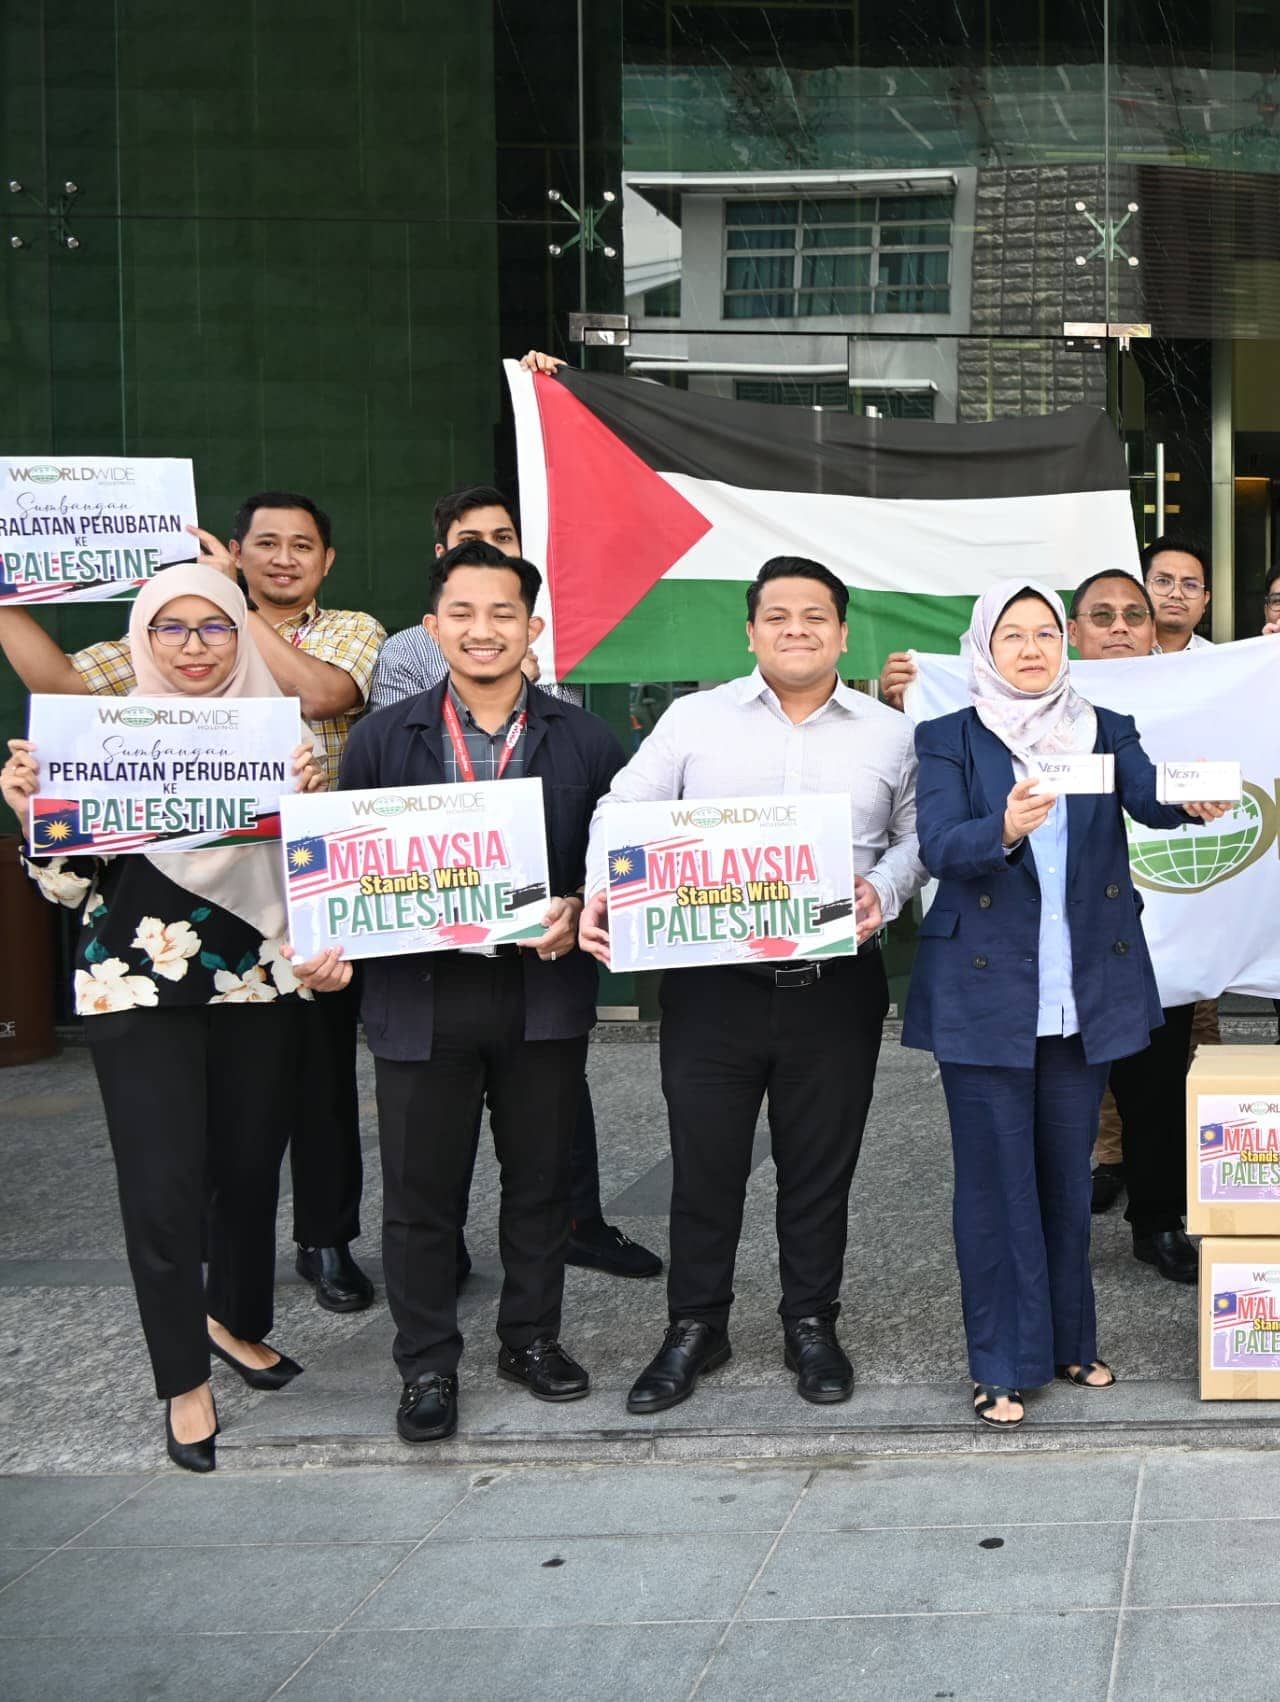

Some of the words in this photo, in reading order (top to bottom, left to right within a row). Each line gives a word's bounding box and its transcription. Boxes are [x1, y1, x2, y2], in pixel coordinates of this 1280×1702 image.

[17, 492, 134, 520] Sumbangan
[0, 517, 75, 536] RALATAN
[80, 515, 181, 534] PERUBATAN
[75, 536, 88, 546] KE
[4, 549, 158, 582] PALESTINE
[102, 735, 234, 764] Sumbangan
[50, 762, 165, 782] PERALATAN
[173, 762, 285, 781] PERUBATAN
[163, 783, 177, 794] KE
[82, 798, 256, 832] PALESTINE
[328, 830, 507, 880] MALAYSIA
[648, 844, 816, 890] MALAYSIA
[360, 871, 430, 896] Stands
[434, 867, 480, 888] With
[677, 885, 743, 907] Stands
[747, 881, 790, 901] With
[328, 882, 513, 935] PALESTINE
[646, 897, 820, 945] PALESTINE
[1240, 1150, 1279, 1164] Stands
